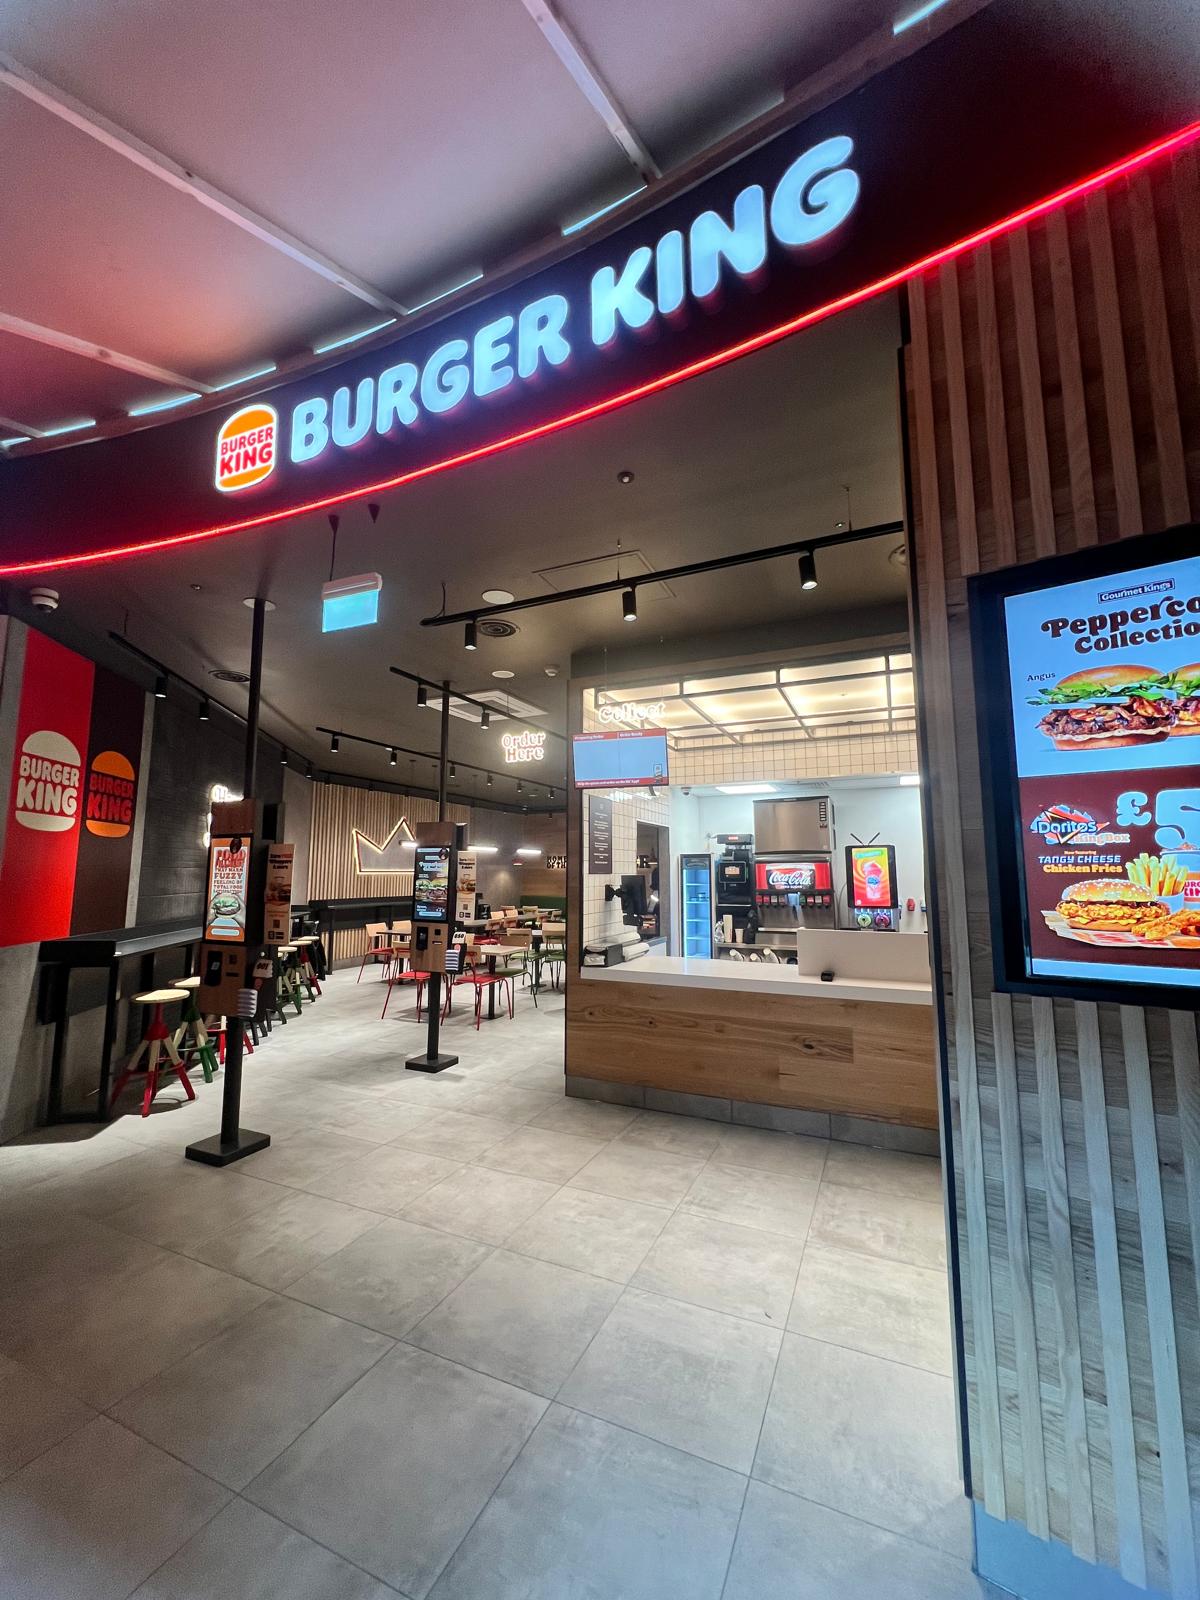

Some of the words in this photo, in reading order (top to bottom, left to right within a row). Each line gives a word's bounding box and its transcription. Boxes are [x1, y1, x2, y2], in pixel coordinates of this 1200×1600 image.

[290, 294, 571, 464] BURGER
[590, 136, 861, 346] KING
[220, 426, 273, 456] BURGER
[219, 442, 273, 477] KING
[1101, 588, 1143, 600] Gourmet
[1144, 582, 1171, 592] Kings
[1041, 596, 1200, 638] Pepperco
[1074, 619, 1200, 653] Collectio
[1026, 672, 1056, 682] Angus
[502, 731, 546, 748] Order
[505, 747, 544, 763] Here
[19, 755, 80, 787] BURGER
[16, 777, 78, 816] KING
[89, 773, 134, 799] BURGER
[87, 792, 133, 823] KING
[1037, 821, 1097, 834] Doritos
[1038, 855, 1074, 863] TANGY
[1077, 855, 1121, 863] CHEESE
[1043, 863, 1091, 873] Chicken
[1091, 863, 1123, 873] Fries
[769, 870, 813, 885] Coca-Cola
